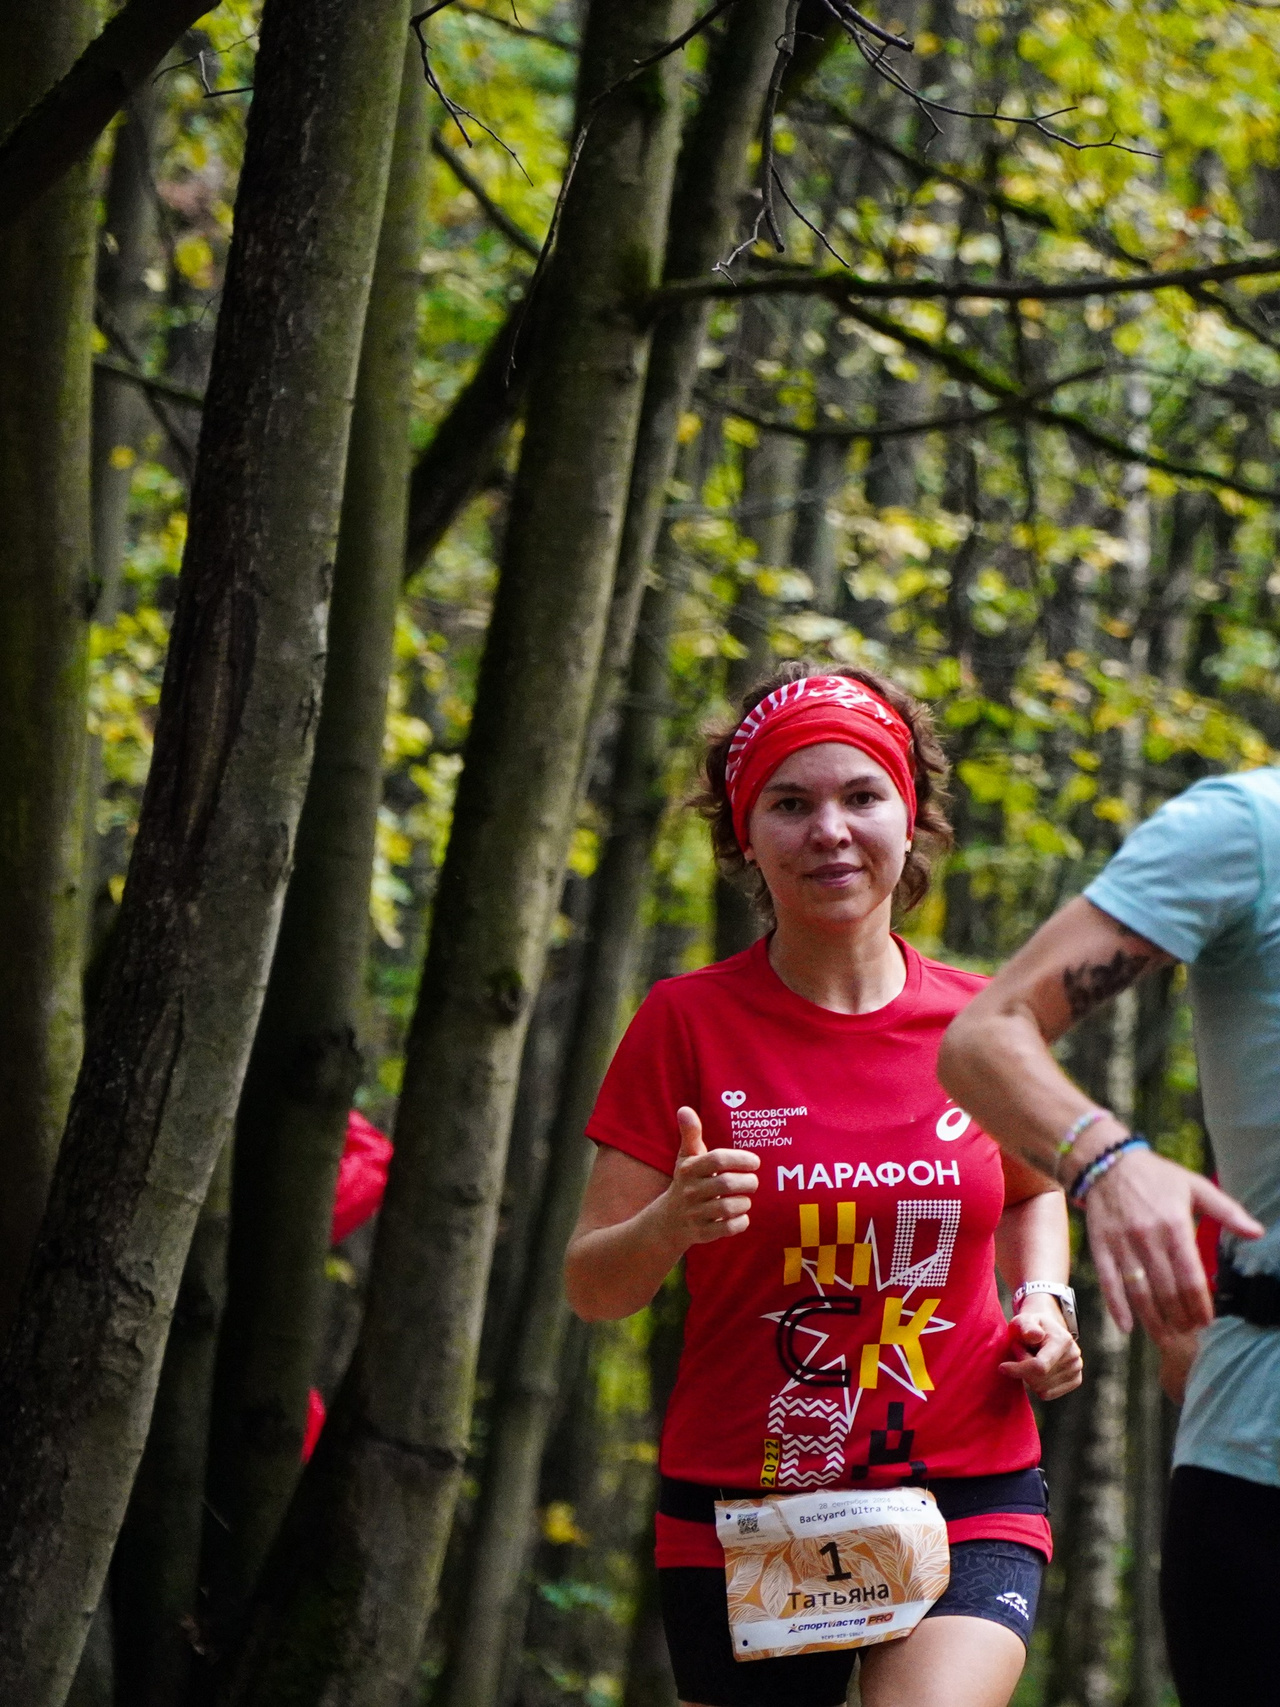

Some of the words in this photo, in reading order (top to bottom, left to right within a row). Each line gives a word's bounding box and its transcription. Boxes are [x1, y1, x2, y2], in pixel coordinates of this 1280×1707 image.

[730, 1106, 808, 1119] МОСКОВСКИЙ
[731, 1118, 787, 1129] МАРАФОН
[732, 1128, 781, 1139] MOSCOW
[733, 1137, 793, 1149] MARATHON
[776, 1160, 961, 1192] МАРАФОН
[760, 1440, 779, 1488] 2022
[799, 1508, 847, 1524] Backyard
[850, 1506, 882, 1516] Ultra
[818, 1541, 852, 1583] 1
[787, 1580, 890, 1611] Татьяна
[867, 1613, 894, 1625] PRO
